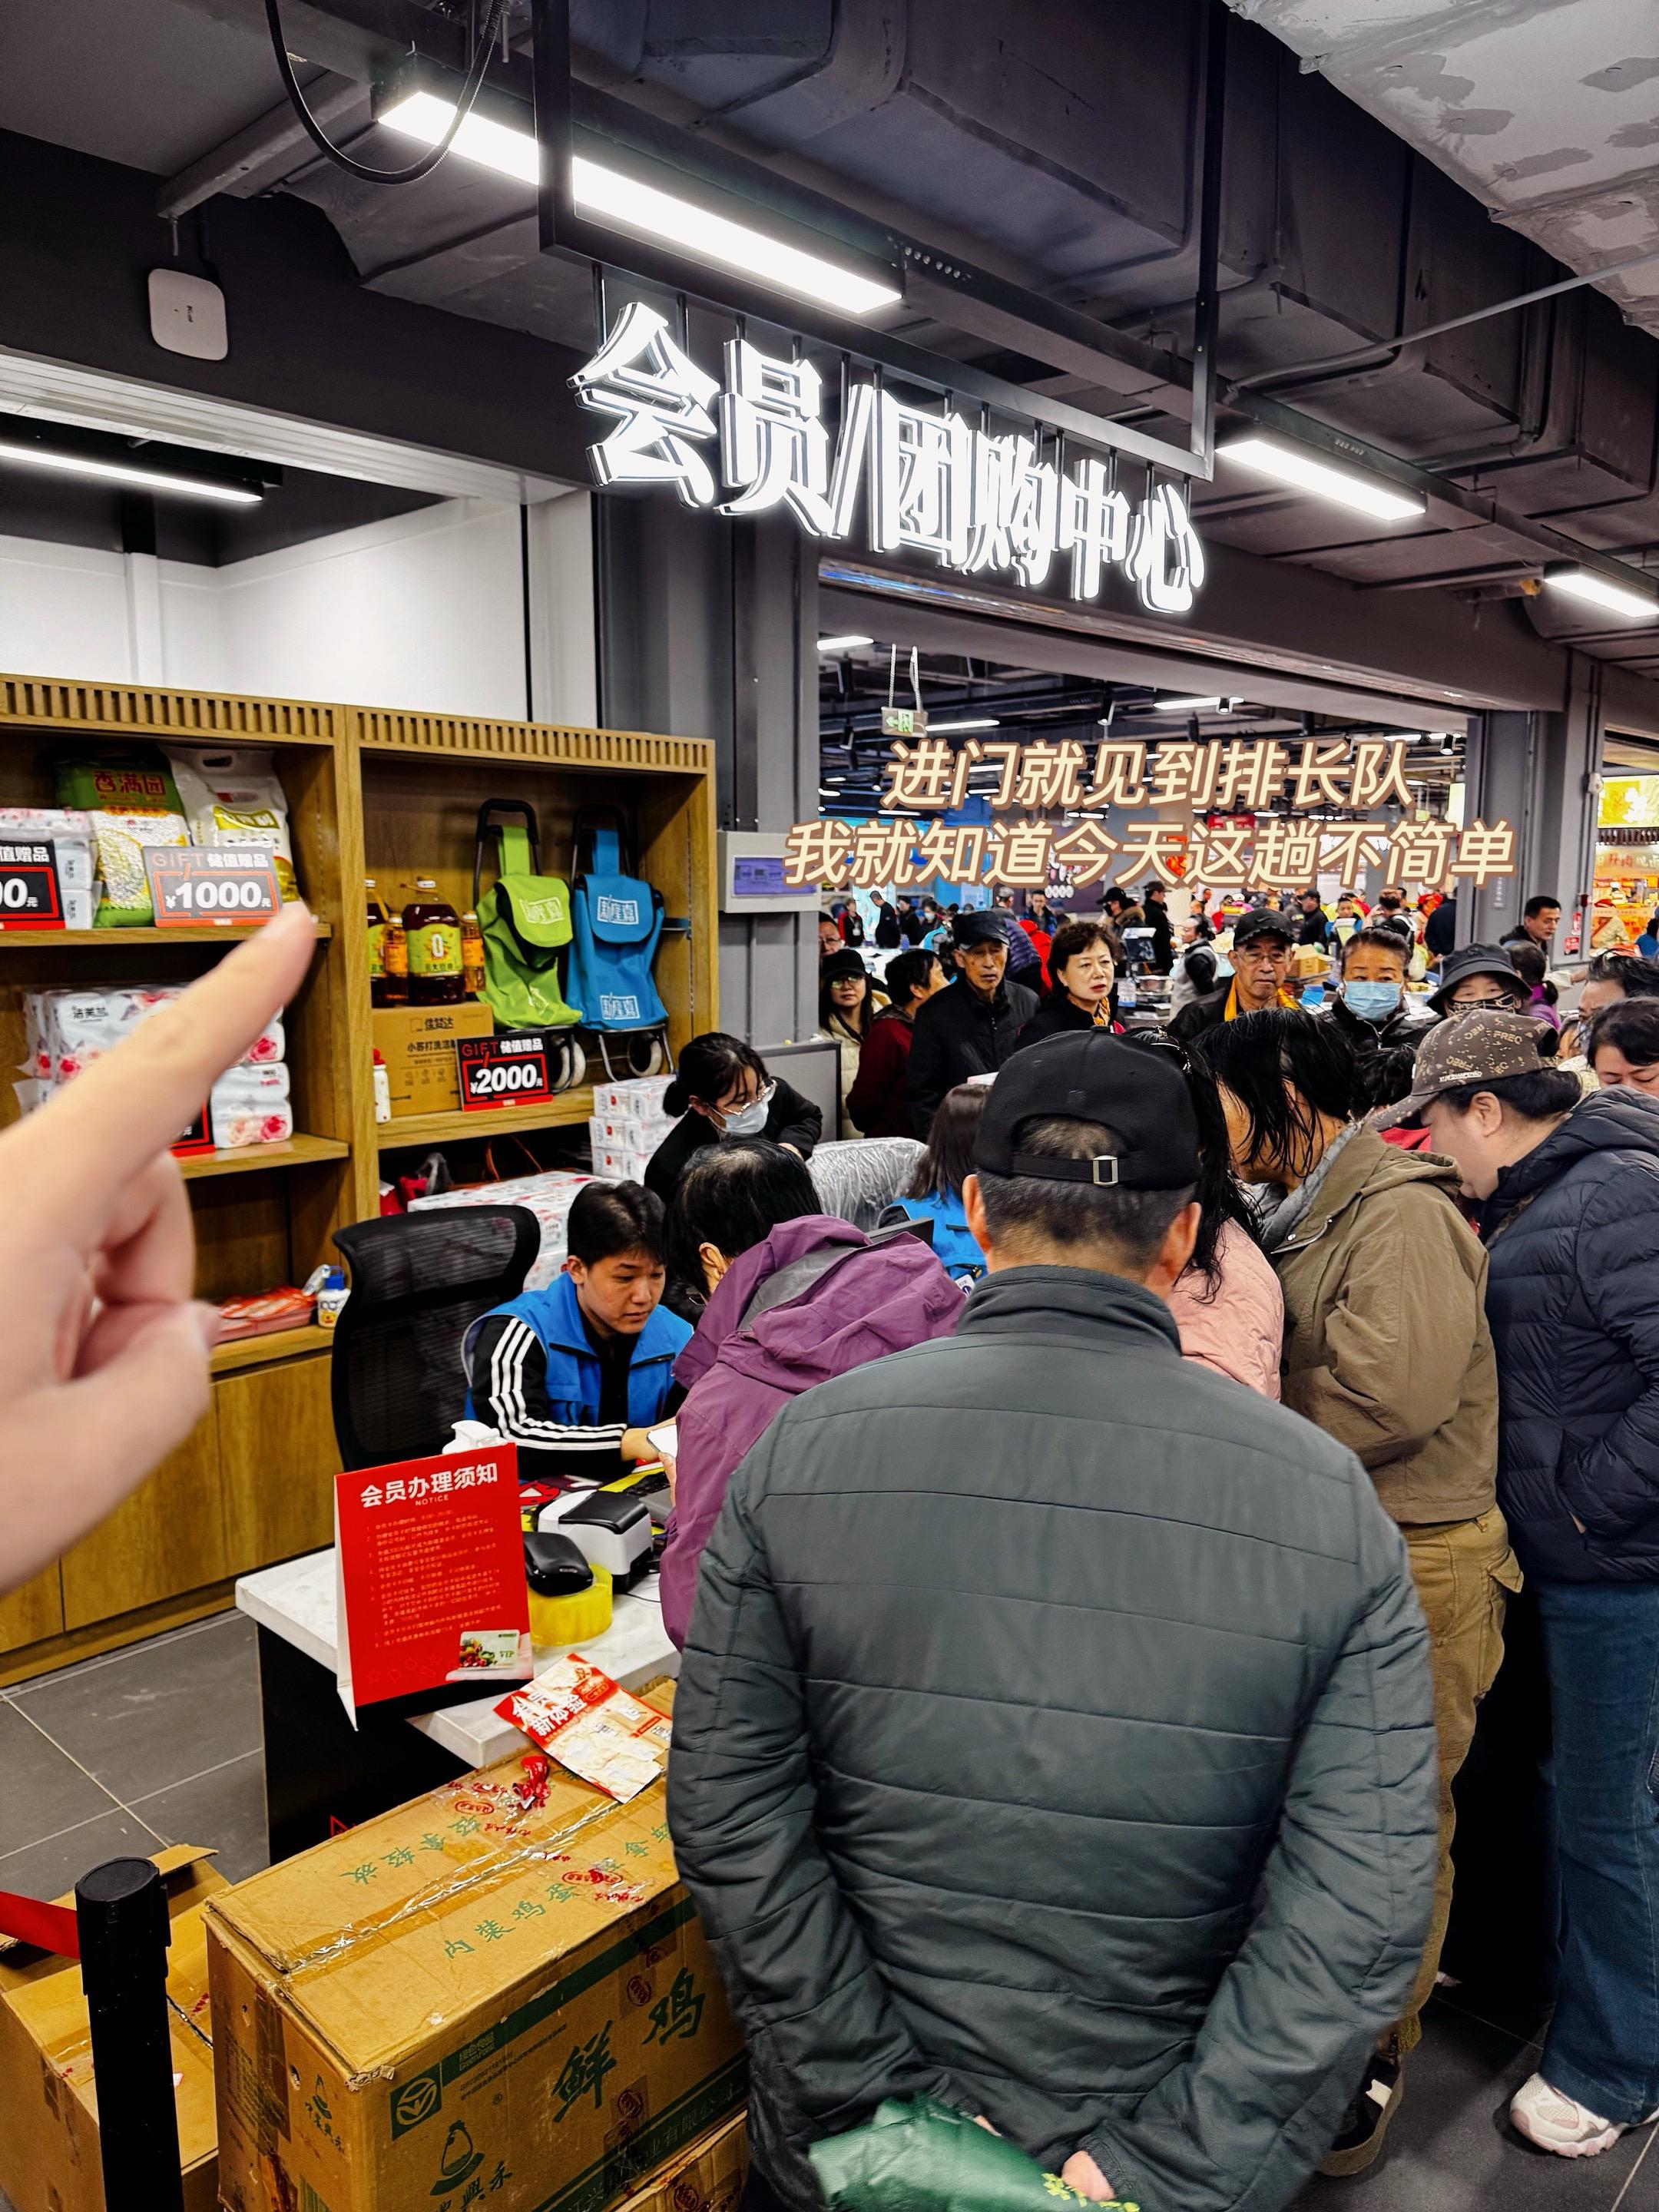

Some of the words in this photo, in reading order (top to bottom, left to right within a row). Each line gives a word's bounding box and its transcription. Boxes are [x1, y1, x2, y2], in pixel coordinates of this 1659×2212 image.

[566, 301, 1206, 613] 会员/团购中心
[152, 853, 204, 867] GIFT
[207, 853, 269, 868] 储值赠品
[461, 1041, 499, 1058] GIFT
[500, 1037, 544, 1055] 储值赠品
[360, 1462, 498, 1508] 会员办理须知
[416, 1494, 449, 1506] NOTICE
[444, 1883, 578, 1959] 内装鸡蛋
